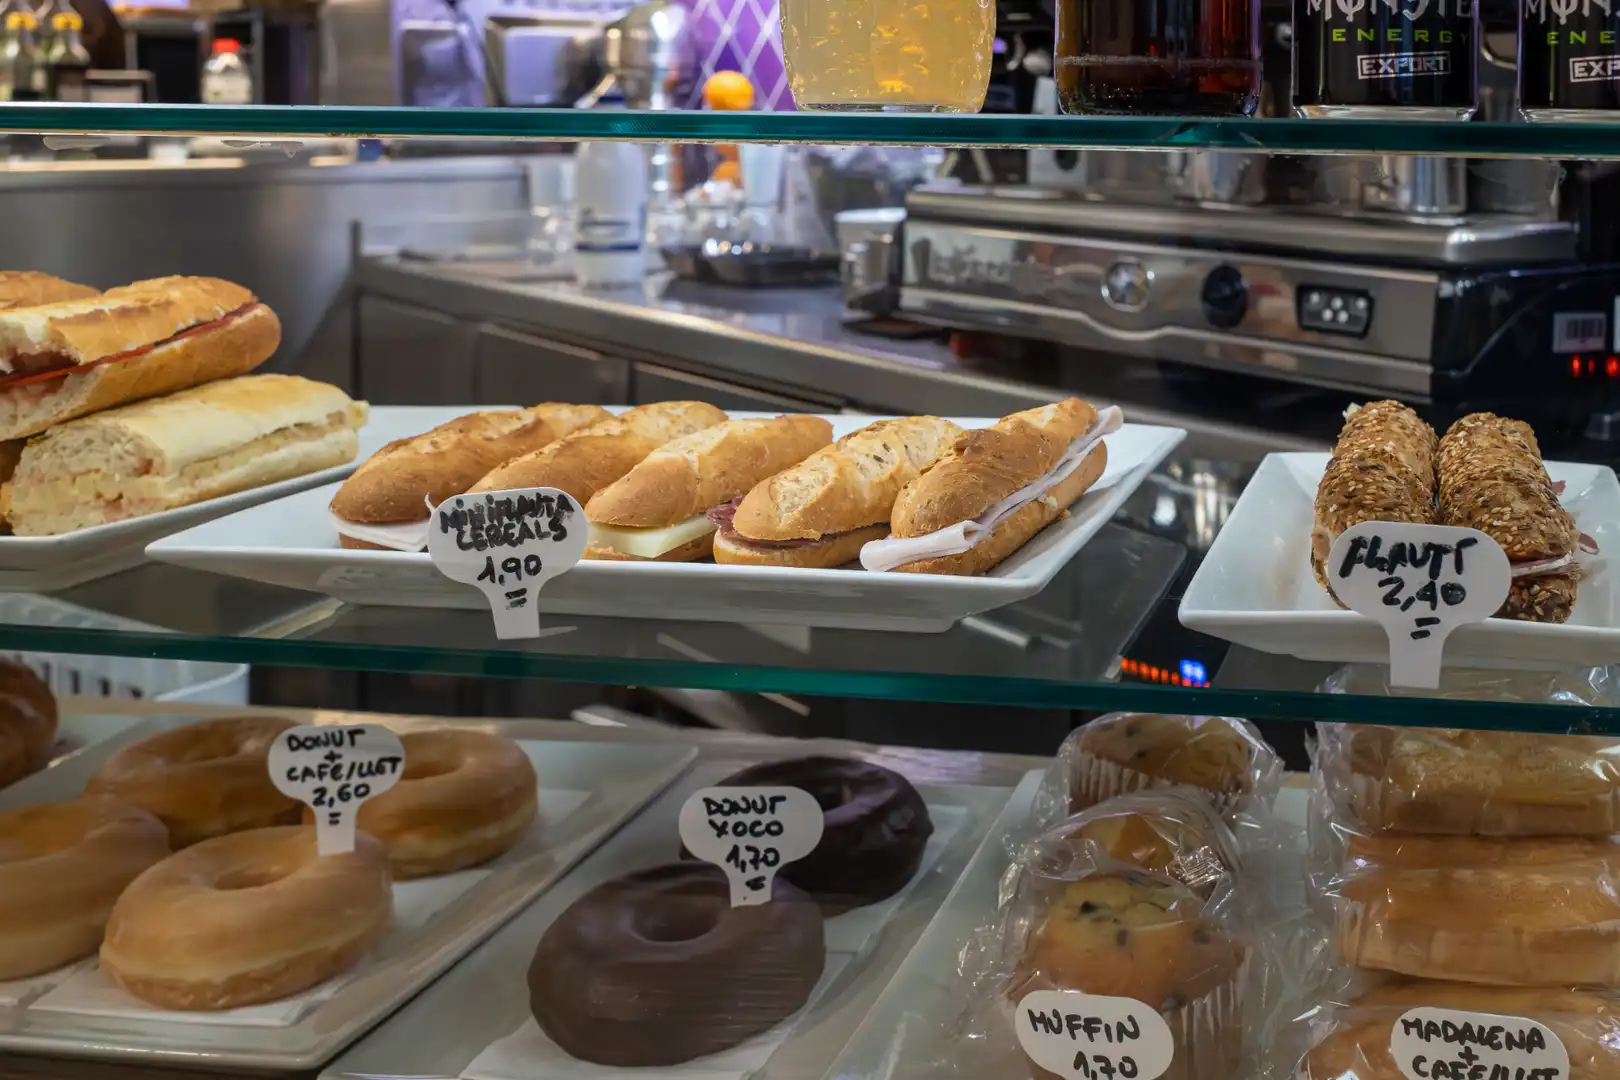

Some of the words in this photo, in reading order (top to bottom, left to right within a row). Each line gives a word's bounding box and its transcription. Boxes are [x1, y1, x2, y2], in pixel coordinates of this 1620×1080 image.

[1361, 55, 1447, 75] EXPORT
[477, 555, 542, 586] 1,90
[1378, 576, 1466, 611] 2,40
[287, 729, 366, 751] DONUT
[312, 783, 370, 807] 2,60
[703, 795, 787, 816] DONUT
[708, 819, 784, 838] XOCO
[725, 844, 780, 873] 1,70
[1027, 1008, 1140, 1043] MUFFIN
[1401, 1017, 1546, 1053] MADALENA
